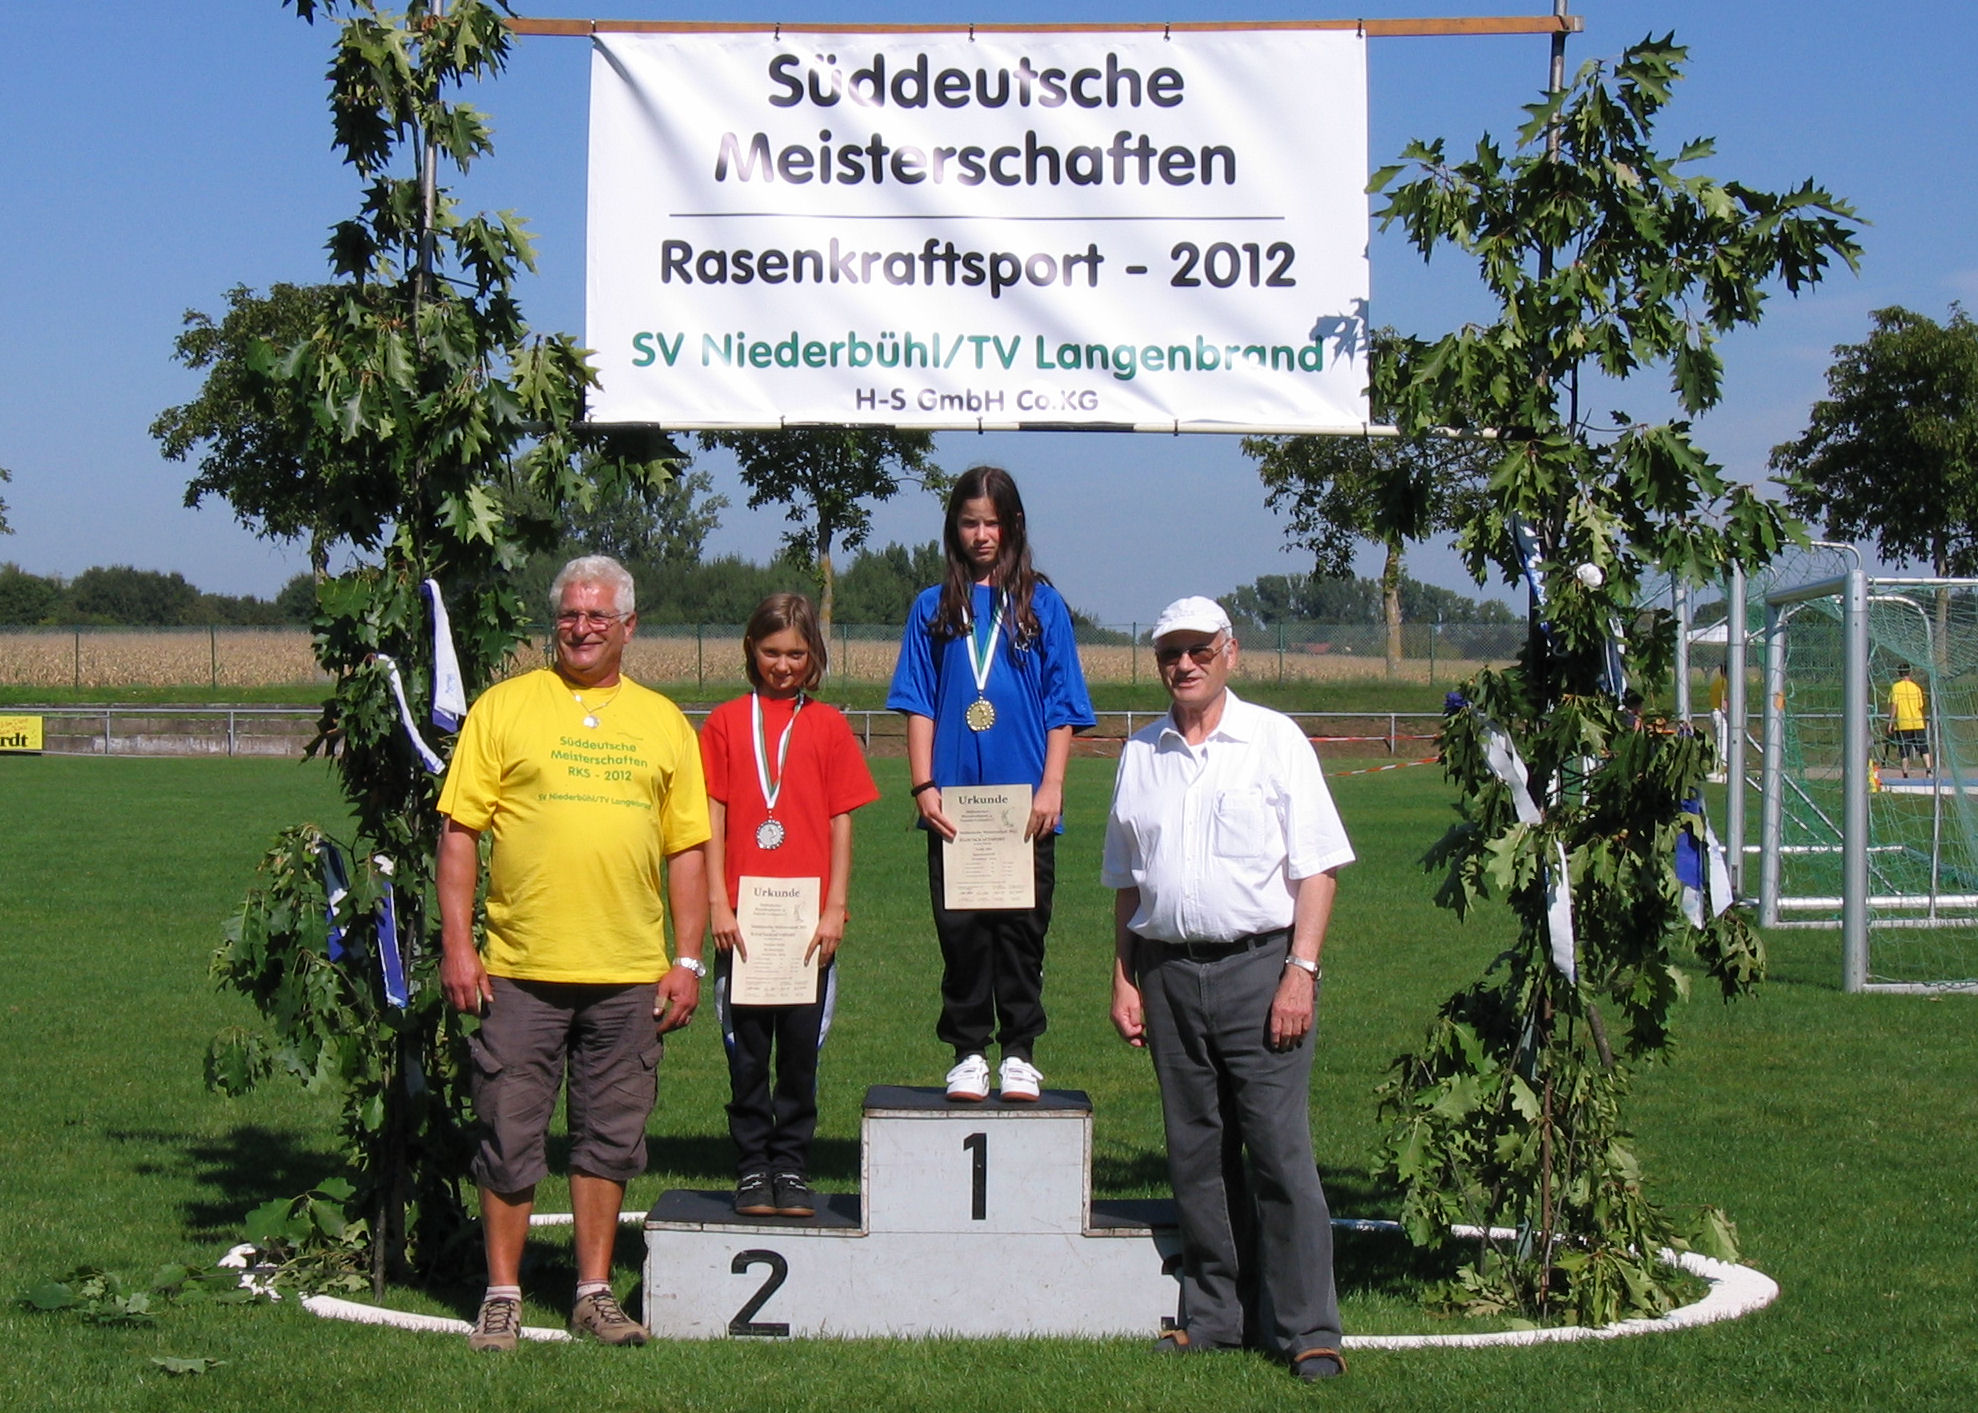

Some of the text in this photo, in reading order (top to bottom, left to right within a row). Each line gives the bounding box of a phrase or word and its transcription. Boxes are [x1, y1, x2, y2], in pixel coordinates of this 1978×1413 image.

[768, 52, 1185, 109] Süddeutsche
[714, 129, 1237, 186] Meisterschaften
[661, 237, 1298, 299] Rasenkraftsport - 2012
[632, 331, 1324, 381] SV Niederbühl/TV Langenbrand
[856, 388, 907, 411] H-S
[917, 388, 1005, 413] GmbH
[559, 735, 637, 752] Süddeutsche
[550, 750, 648, 768] Meisterschaften
[568, 766, 591, 778] RKS
[604, 770, 632, 781] 2012
[538, 793, 547, 801] SV
[958, 794, 1009, 806] Urkunde
[754, 887, 801, 898] Urkunde
[963, 1132, 987, 1220] 1
[728, 1249, 790, 1337] 2
